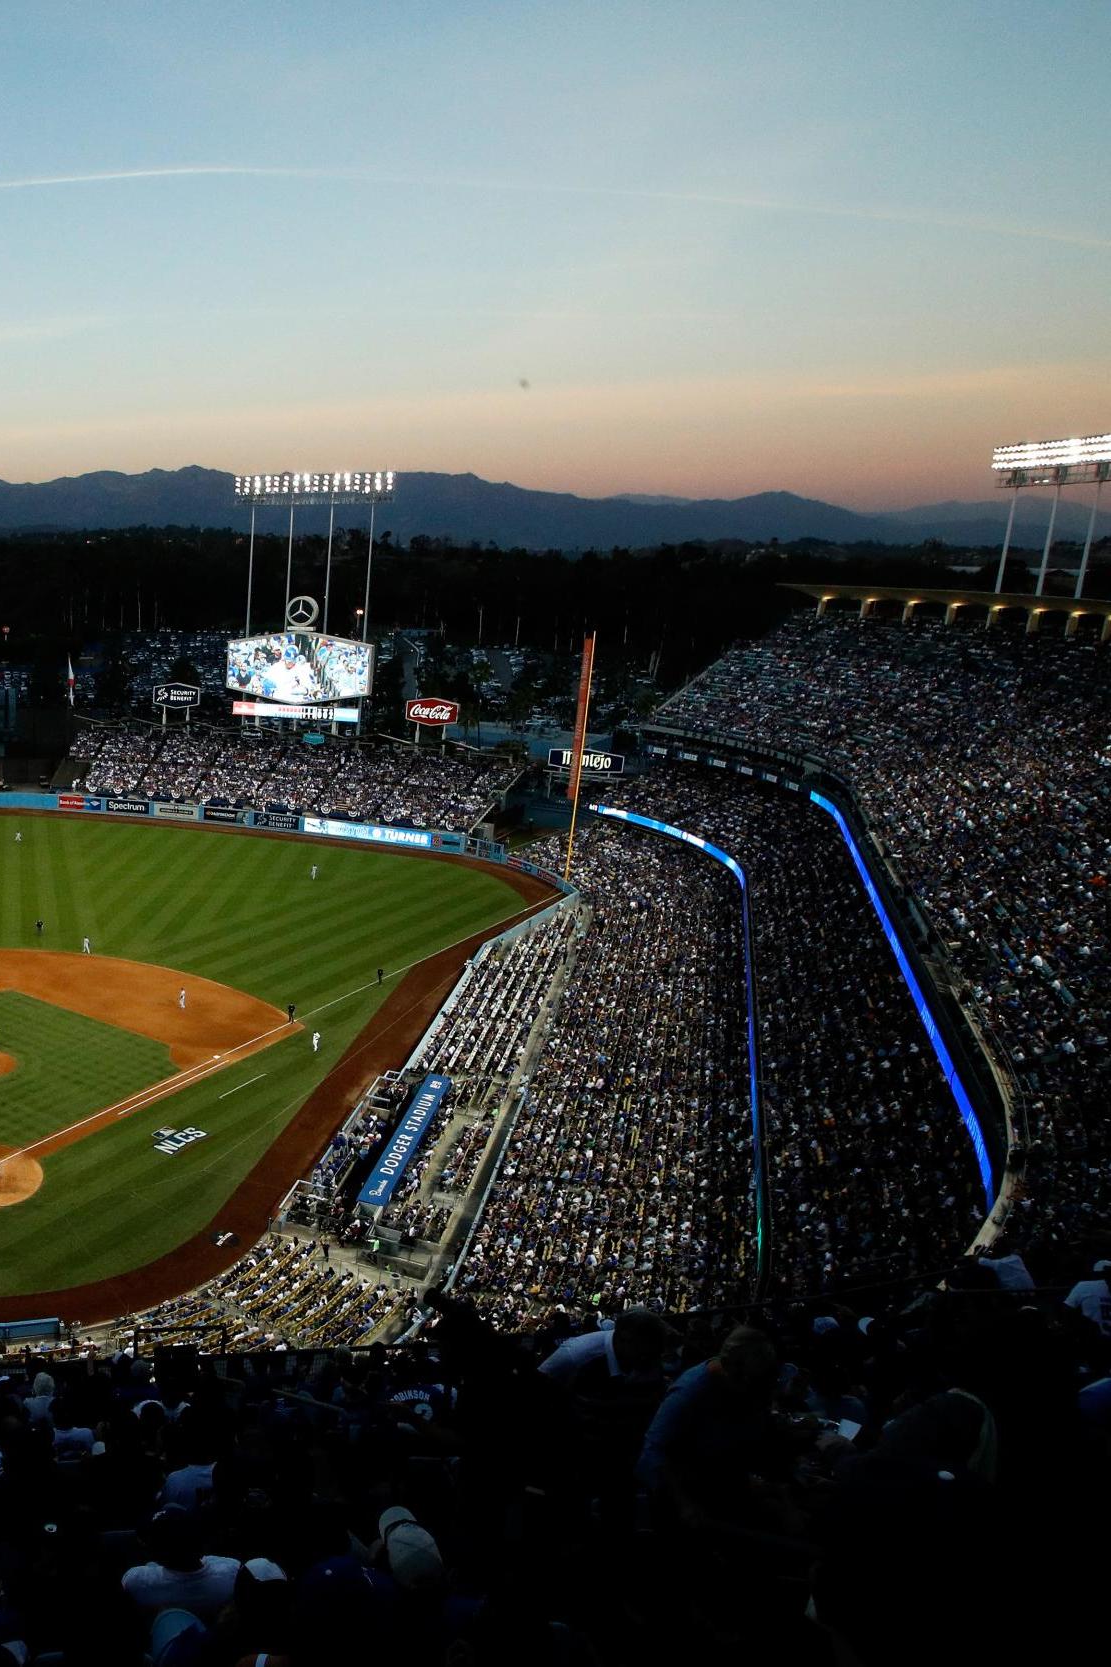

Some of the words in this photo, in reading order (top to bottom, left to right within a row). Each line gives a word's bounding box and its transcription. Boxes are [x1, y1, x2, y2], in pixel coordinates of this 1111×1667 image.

[562, 751, 611, 770] Mntejo
[109, 801, 145, 811] Spectrum
[268, 820, 292, 829] BENEFIT
[269, 815, 296, 823] SECURITY
[154, 1127, 207, 1154] NLCS
[380, 1134, 415, 1175] DODGER
[405, 1094, 436, 1132] STADIUM
[392, 1390, 430, 1402] OBINSON
